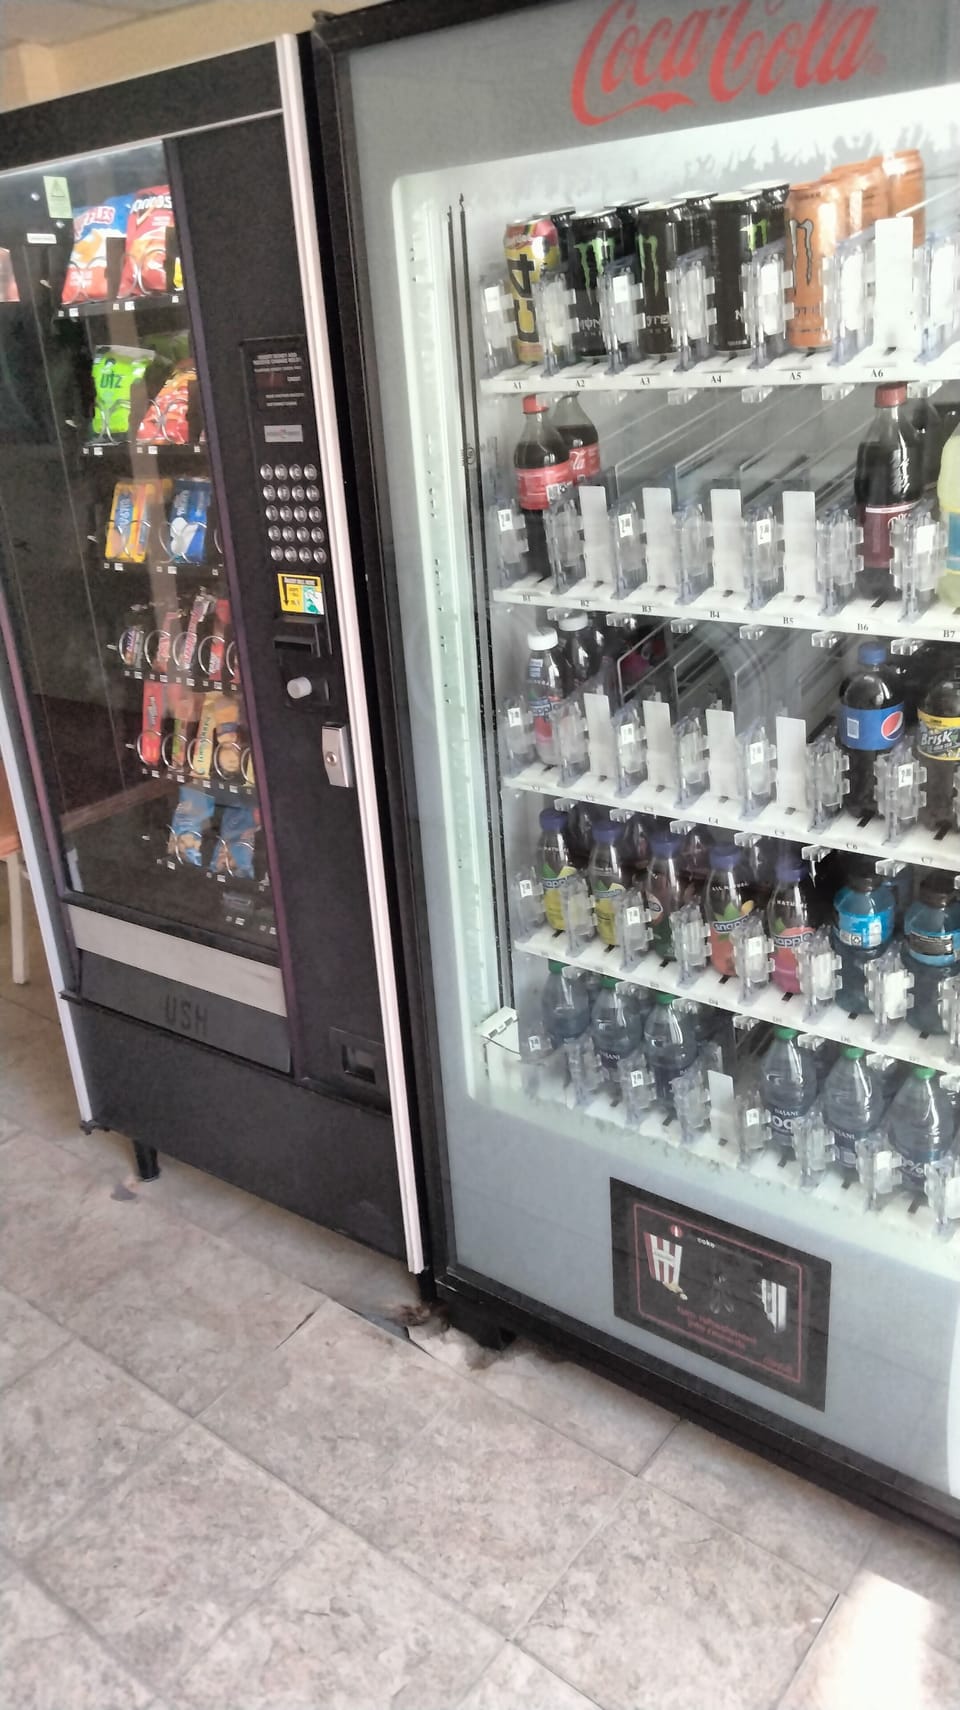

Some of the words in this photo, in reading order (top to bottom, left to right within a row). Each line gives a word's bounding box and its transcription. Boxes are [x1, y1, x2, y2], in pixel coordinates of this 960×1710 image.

[790, 372, 802, 381] A5
[871, 369, 884, 379] A6
[576, 379, 585, 388] A2
[640, 377, 650, 386] A3
[710, 375, 722, 384] A4
[513, 382, 522, 390] A1
[710, 611, 720, 619] B4
[857, 623, 869, 631] B6
[943, 630, 956, 638] B7
